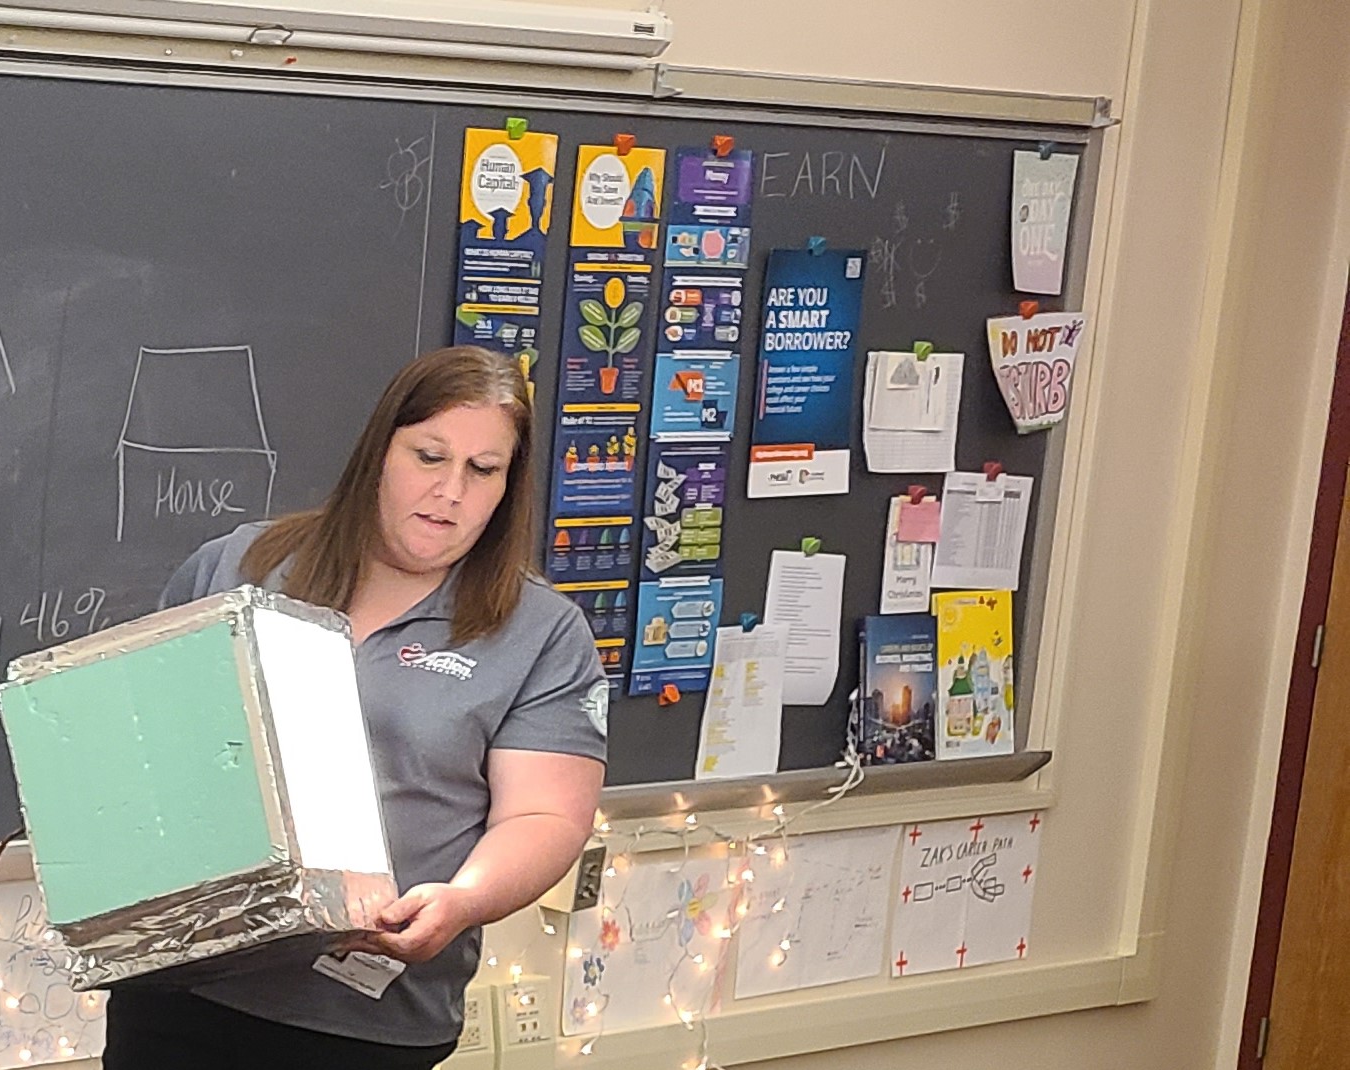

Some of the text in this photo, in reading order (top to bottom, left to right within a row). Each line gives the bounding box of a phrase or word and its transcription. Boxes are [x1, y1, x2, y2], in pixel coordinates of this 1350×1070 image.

[479, 158, 516, 174] Human
[767, 287, 828, 306] ARE YOU
[765, 309, 830, 329] A SMART
[764, 331, 850, 351] BORROWER?
[1001, 326, 1062, 358] DO NOT
[155, 466, 247, 519] House
